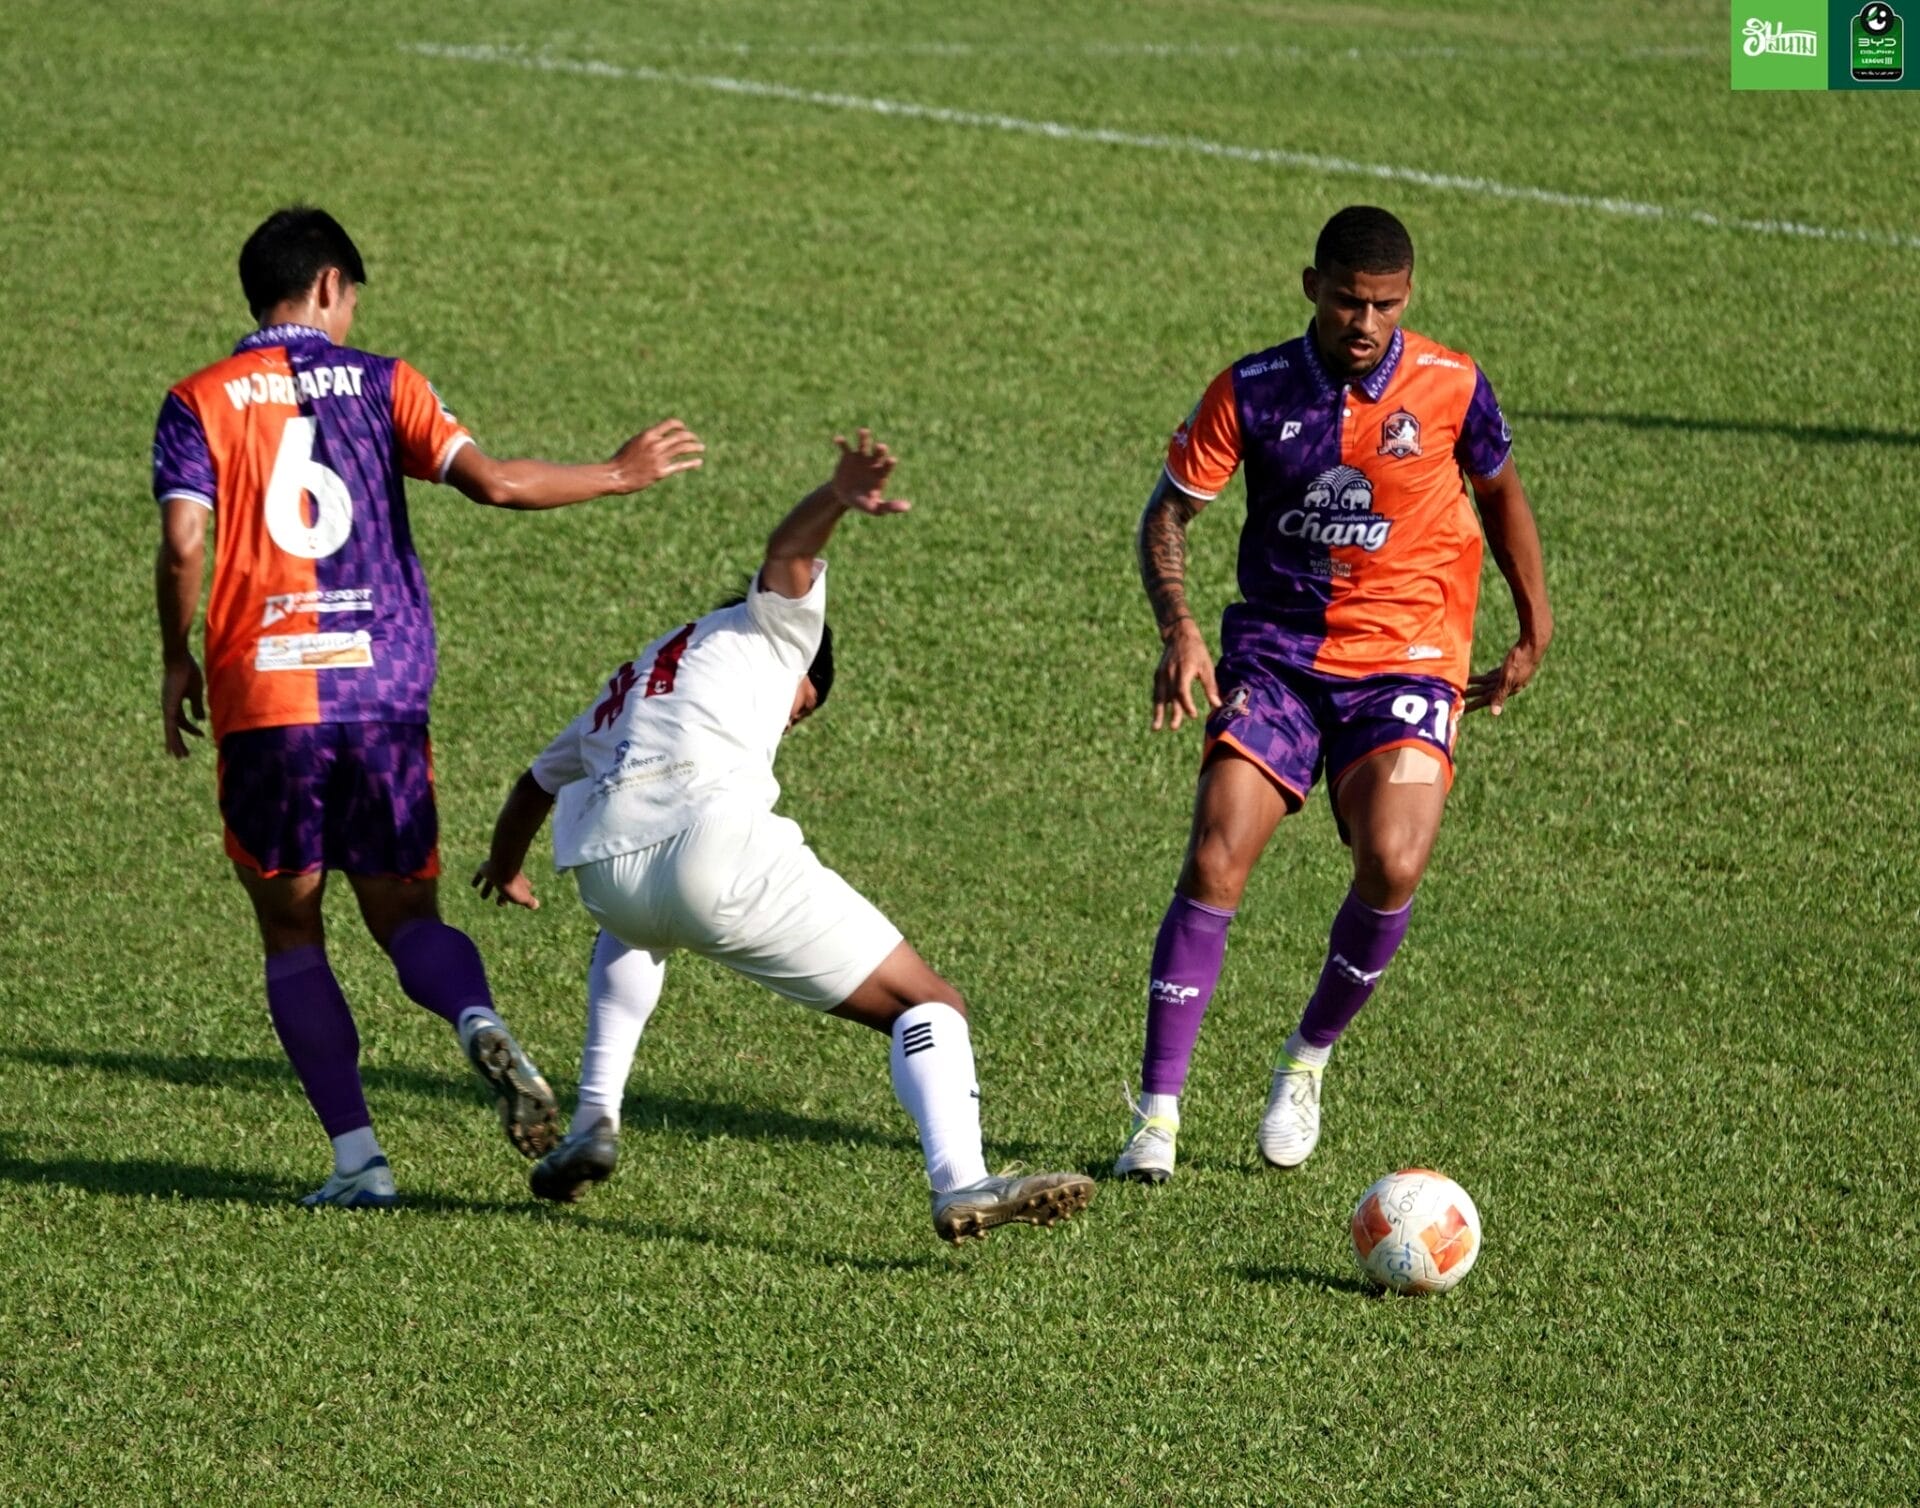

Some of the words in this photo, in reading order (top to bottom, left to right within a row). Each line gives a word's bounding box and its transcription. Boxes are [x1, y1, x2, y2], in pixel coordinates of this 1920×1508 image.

[264, 416, 353, 559] 6
[1278, 509, 1392, 551] Chang
[1391, 695, 1449, 744] 91
[1151, 980, 1199, 998] PKP
